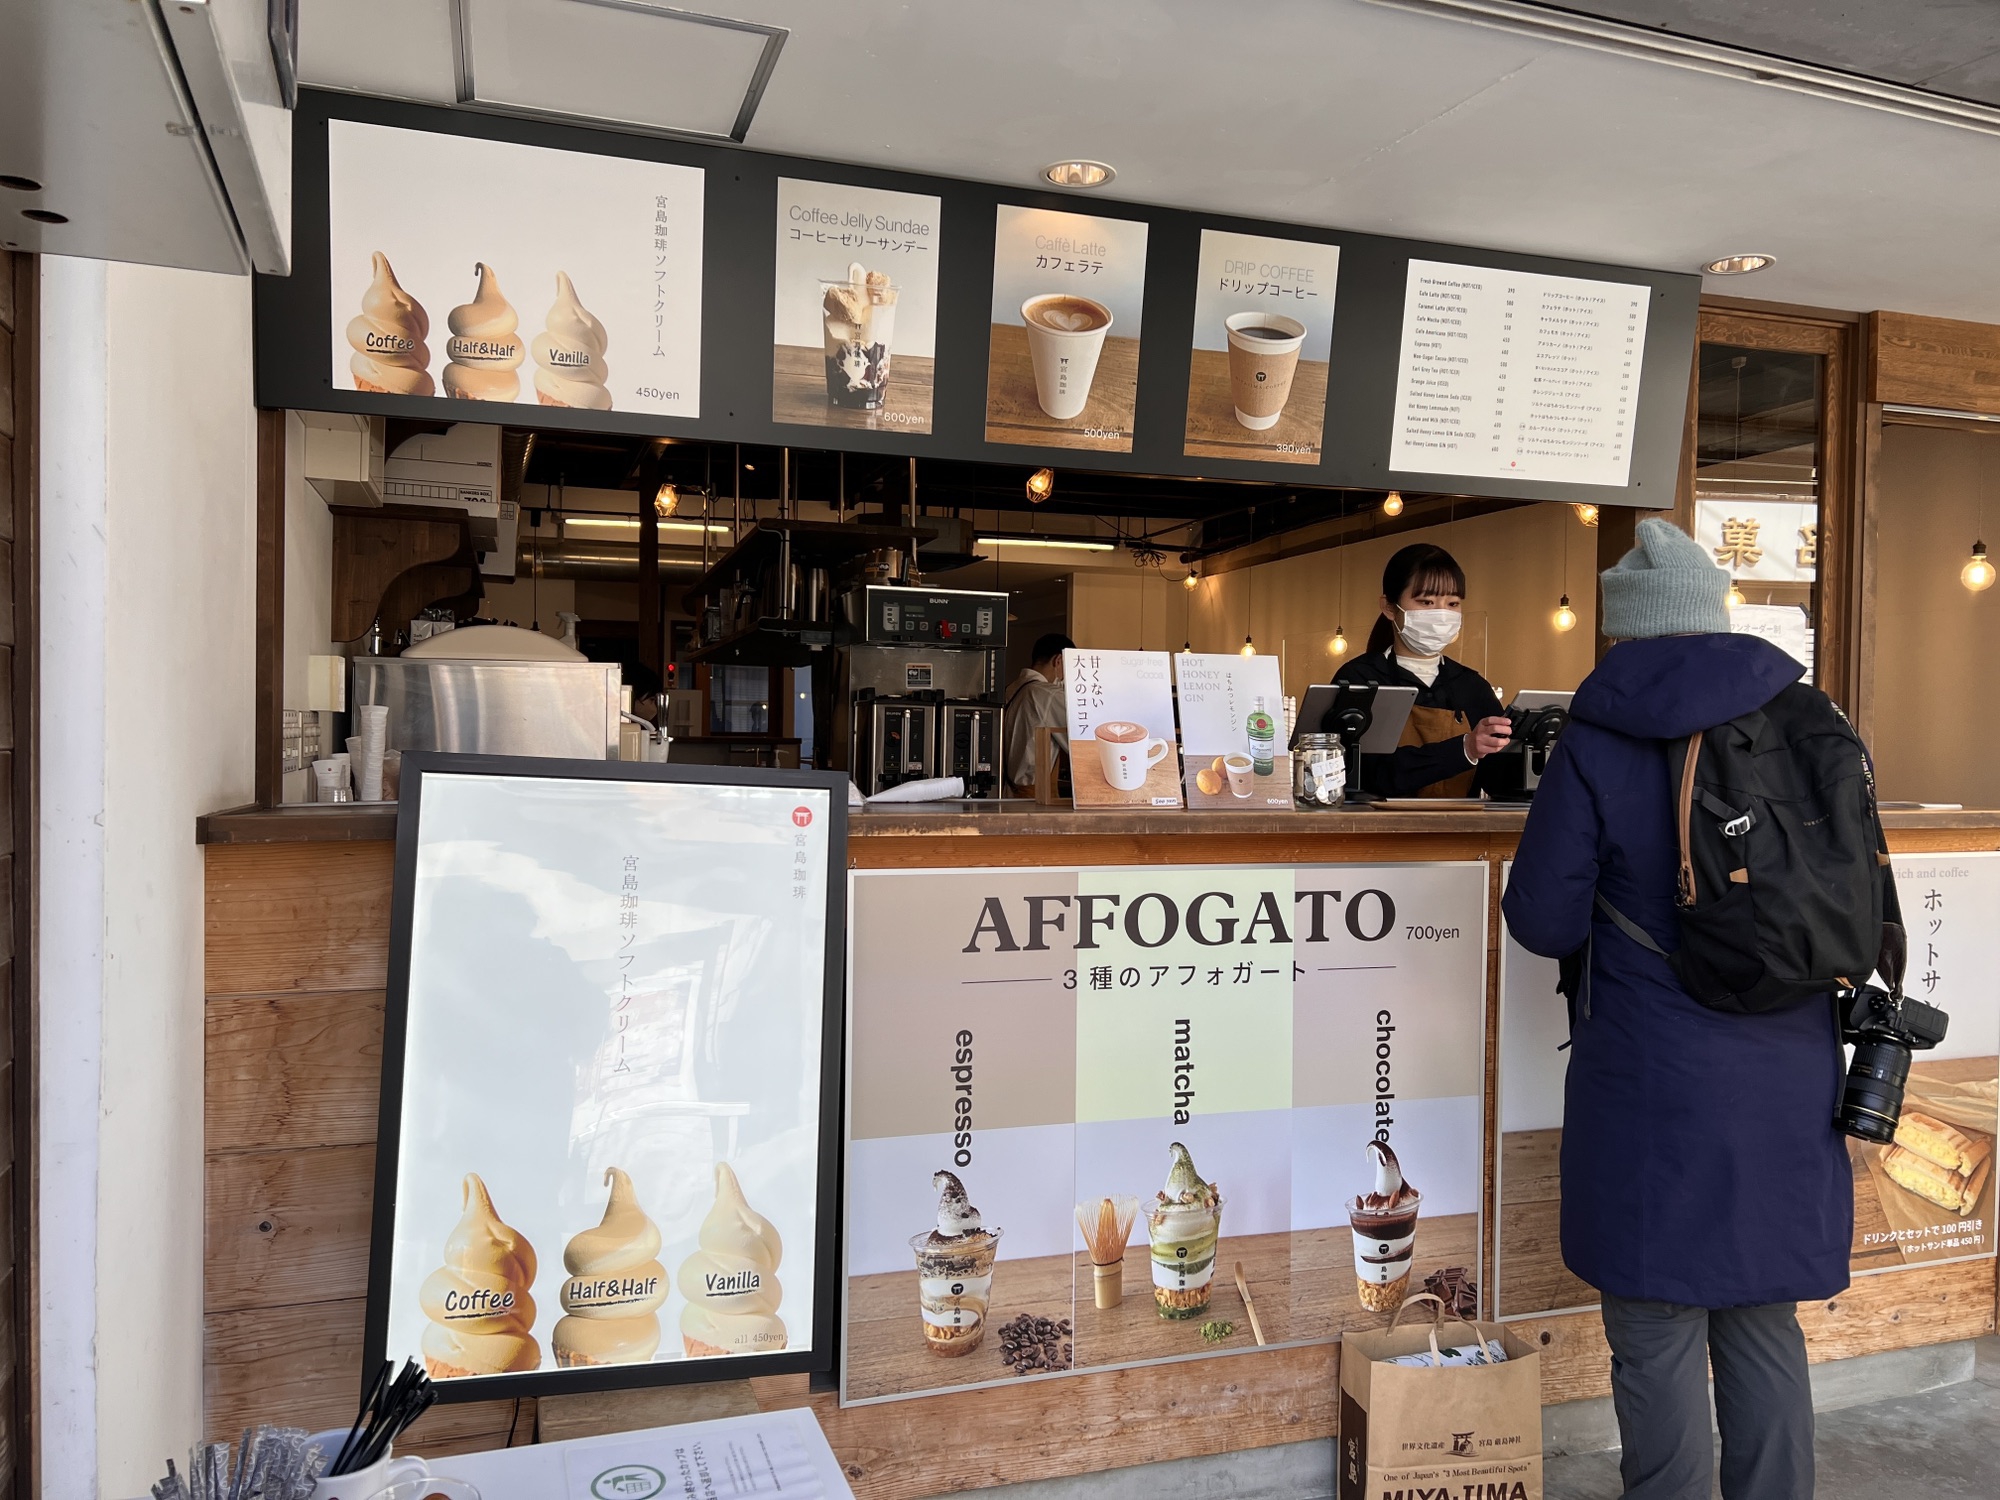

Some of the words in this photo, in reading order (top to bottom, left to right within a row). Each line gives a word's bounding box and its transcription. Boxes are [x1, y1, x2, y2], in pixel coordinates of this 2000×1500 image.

[789, 205, 838, 226] Coffee
[840, 211, 873, 231] Jelly
[875, 215, 930, 236] Sundae
[789, 227, 929, 253] コーヒーゼリーサンデー
[1035, 235, 1071, 253] Caffè
[1072, 239, 1107, 257] Latte
[1035, 254, 1104, 275] カフェラテ
[1224, 259, 1256, 275] DRIP
[1260, 264, 1314, 283] COFFEE
[653, 195, 668, 357] 宮島珈琲ソフトクリーム
[1219, 278, 1318, 299] ドリップコーヒー
[366, 332, 414, 351] Coffee
[453, 340, 515, 358] Half&Half
[549, 349, 590, 365] Vanilla
[636, 387, 680, 401] 450yen
[883, 412, 925, 425] 600yen
[1083, 428, 1120, 441] 500yen
[1276, 443, 1311, 455] 390yen
[1181, 658, 1204, 667] HOT
[1090, 655, 1104, 708] 甘くない
[1137, 670, 1164, 680] Cocoa
[1182, 670, 1220, 679] HONEY
[1074, 654, 1089, 735] 大人のココア
[1183, 682, 1220, 691] LEMON
[1184, 694, 1204, 702] GIN
[792, 833, 808, 900] 宮島珈琲
[1916, 868, 1936, 879] and
[1939, 867, 1969, 878] coffee
[962, 888, 1397, 954] AFFOGATO
[1405, 925, 1460, 943] 700yen
[613, 855, 640, 1074] 宮島珈琲ソフトクリーム
[1063, 961, 1307, 991] 3種のアフォガート
[1173, 1019, 1196, 1127] matcha
[1374, 1010, 1397, 1144] chocolate
[951, 1030, 974, 1168] espresso
[570, 1278, 657, 1300] Half&Half
[706, 1272, 761, 1291] Vanilla
[445, 1290, 514, 1312] Coffee
[735, 1334, 749, 1344] all
[753, 1331, 785, 1344] 450yen
[1402, 1441, 1445, 1451] 世界文化遺産
[1413, 1471, 1439, 1481] Japan's
[1452, 1468, 1470, 1477] Most
[1472, 1465, 1506, 1476] Beautiful
